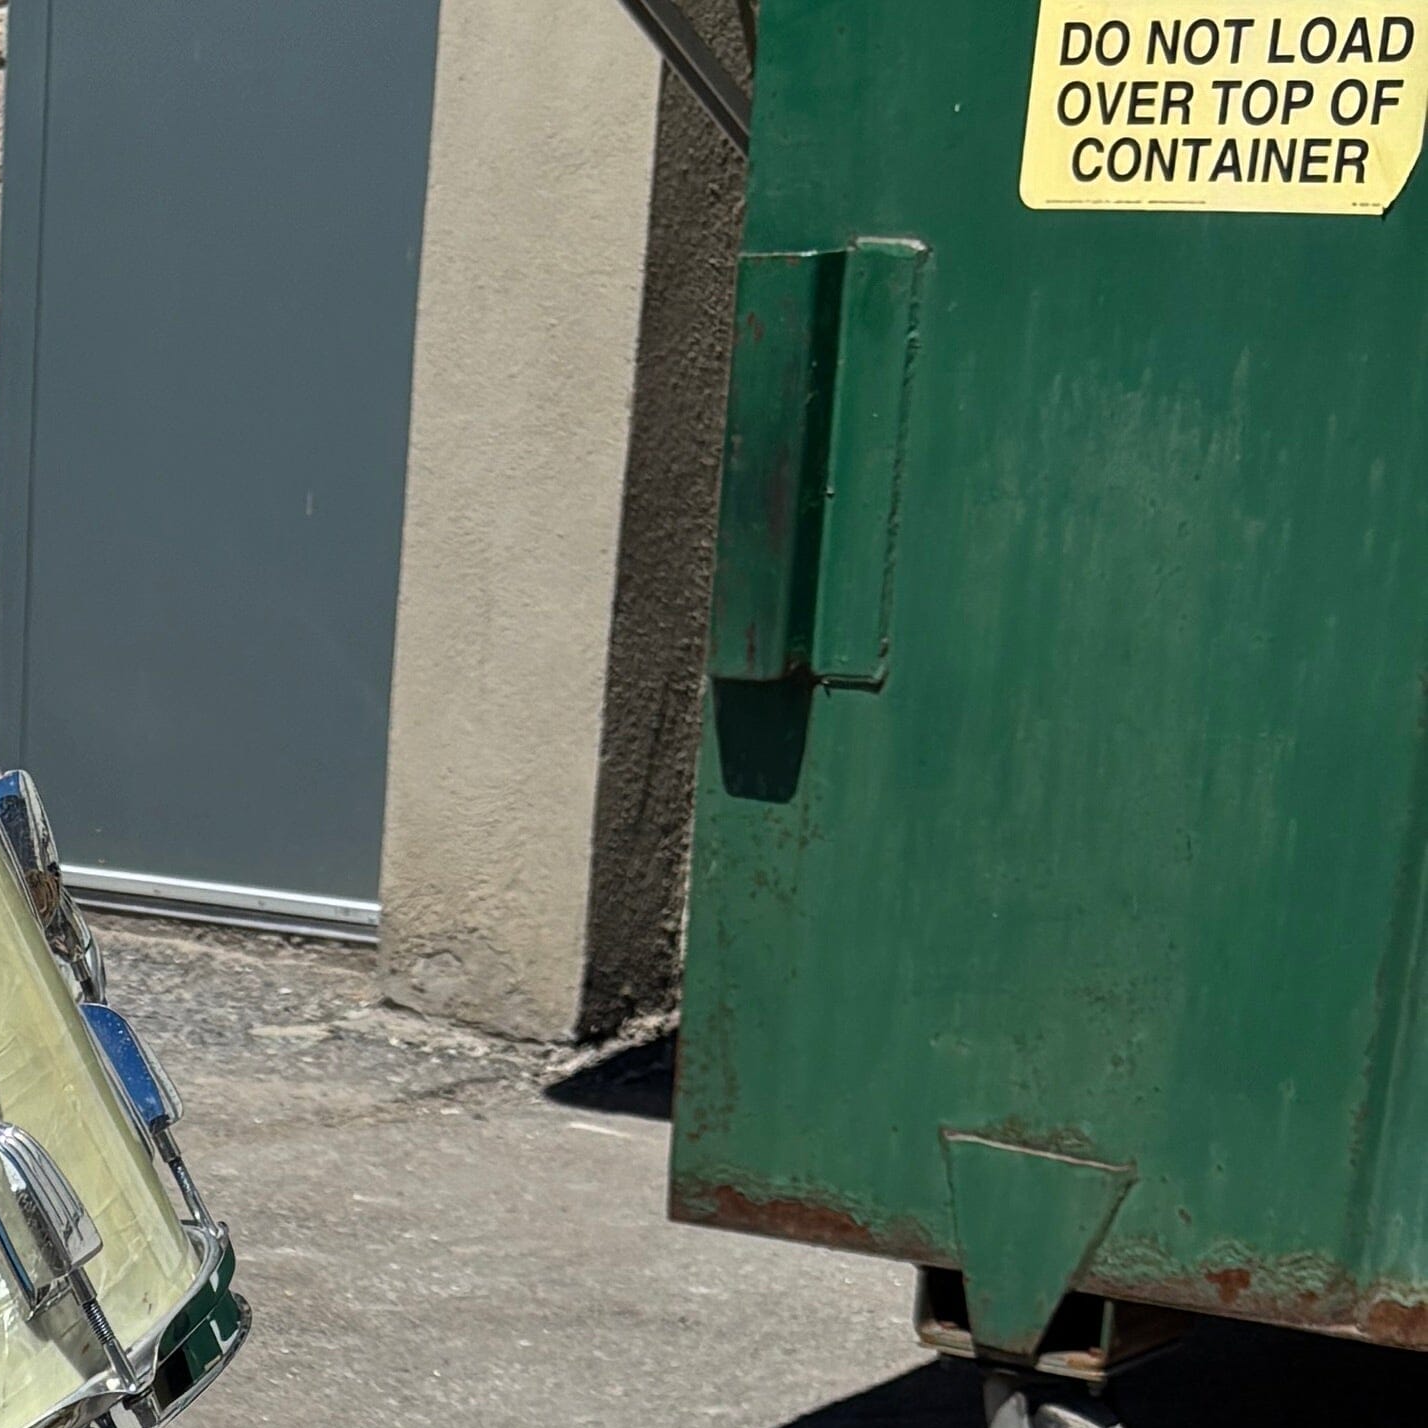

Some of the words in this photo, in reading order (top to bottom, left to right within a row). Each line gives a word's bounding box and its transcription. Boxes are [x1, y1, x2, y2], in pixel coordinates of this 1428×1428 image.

[1059, 20, 1130, 66] DO
[1146, 18, 1255, 65] NOT
[1267, 16, 1415, 64] LOAD
[1057, 80, 1194, 126] OVER
[1211, 79, 1314, 126] TOP
[1330, 78, 1405, 126] OF
[1072, 137, 1369, 184] CONTAINER
